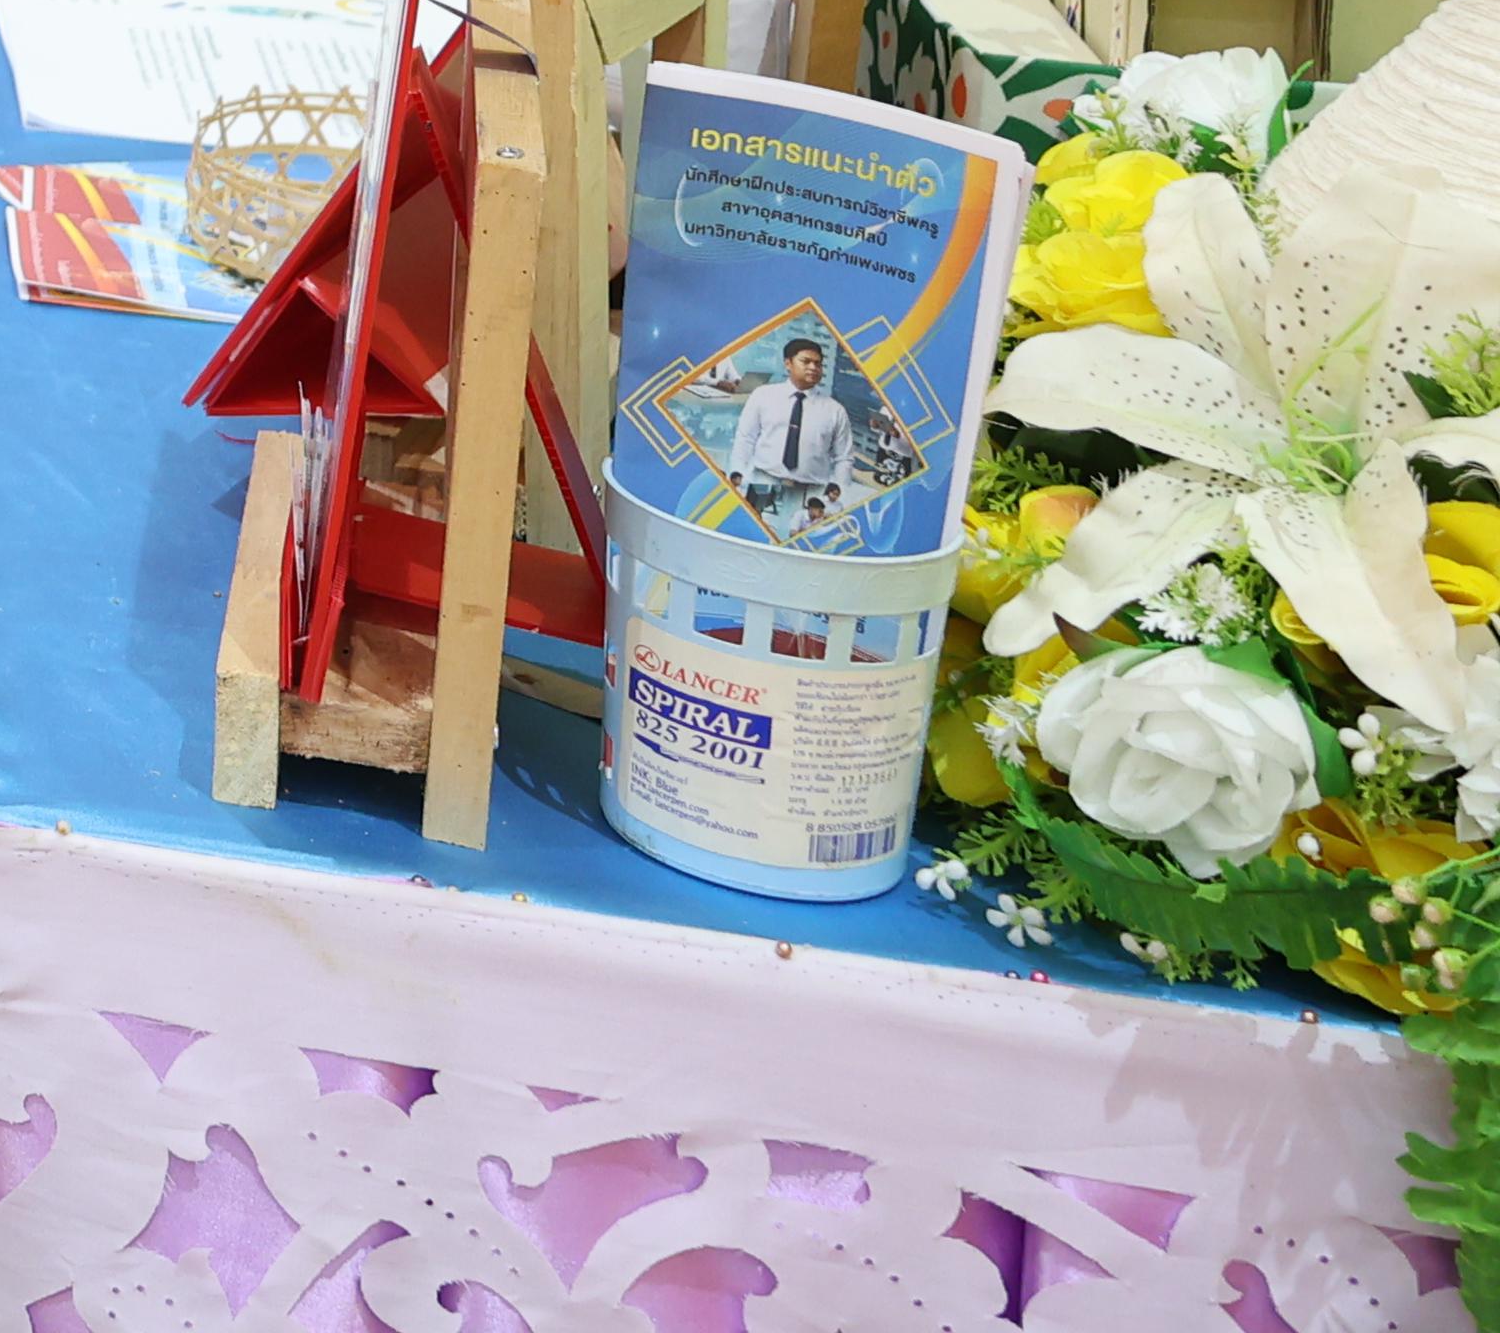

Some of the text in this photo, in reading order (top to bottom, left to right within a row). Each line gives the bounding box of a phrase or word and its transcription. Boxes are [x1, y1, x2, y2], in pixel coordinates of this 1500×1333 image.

[691, 127, 938, 199] เอกสารแนะนำตัว
[684, 165, 941, 240] นักศึกษาฝึกประสบการณ์วิชาชีพครู
[721, 198, 889, 247] สาขาอุตสาหกรรมศิลป์
[634, 678, 761, 745] SPIRAL
[660, 659, 761, 706] LANCER
[636, 708, 680, 744] 825
[689, 734, 766, 771] 2001
